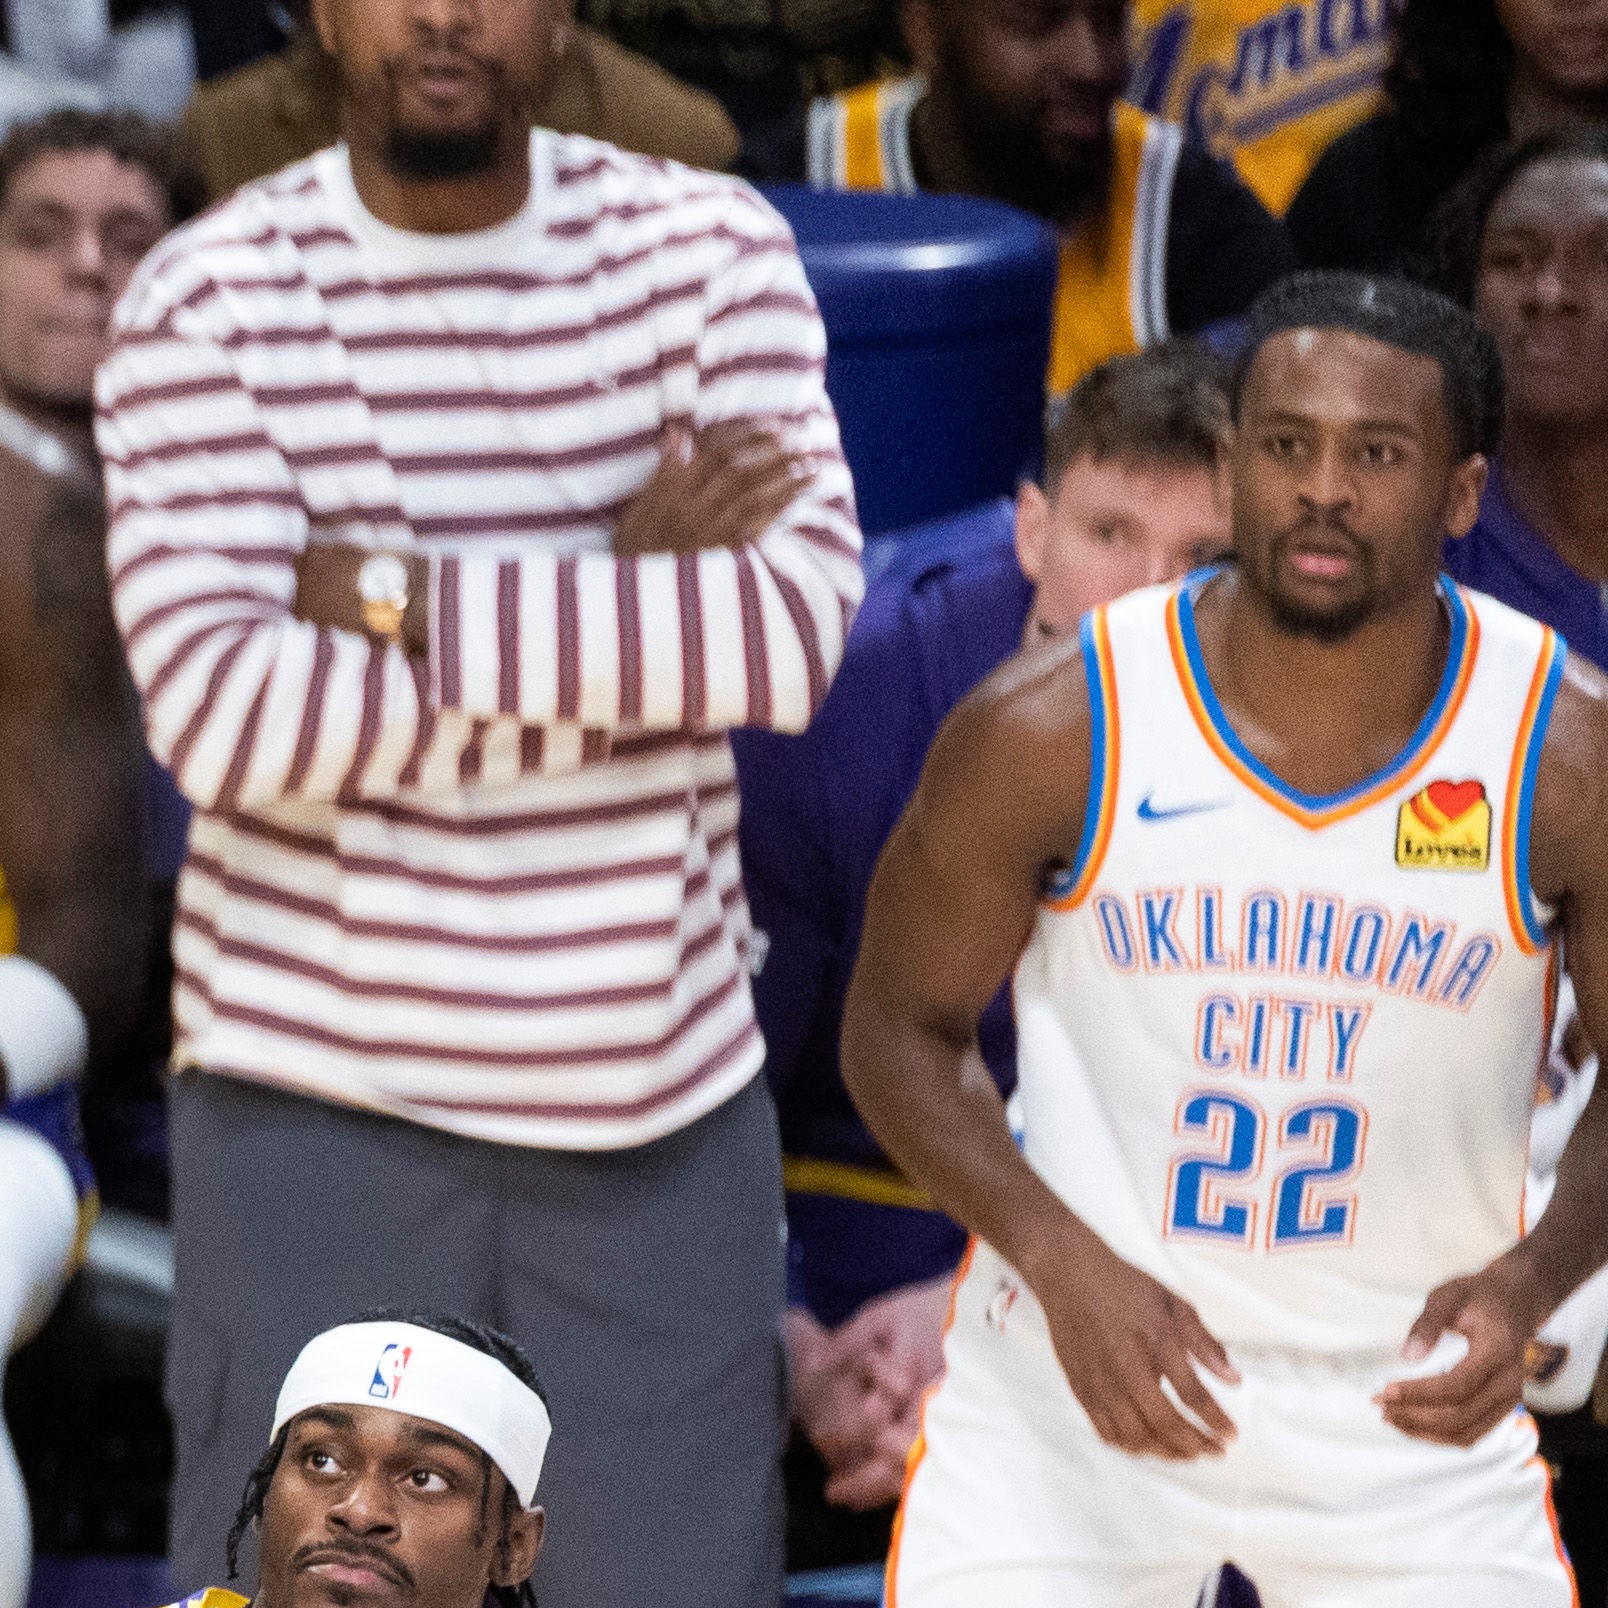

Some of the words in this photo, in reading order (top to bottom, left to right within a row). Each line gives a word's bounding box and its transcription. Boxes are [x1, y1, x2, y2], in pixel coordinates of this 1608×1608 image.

[1091, 885, 1503, 1011] OKLAHOMA
[1195, 994, 1373, 1084] CITY
[1162, 1084, 1370, 1253] 22
